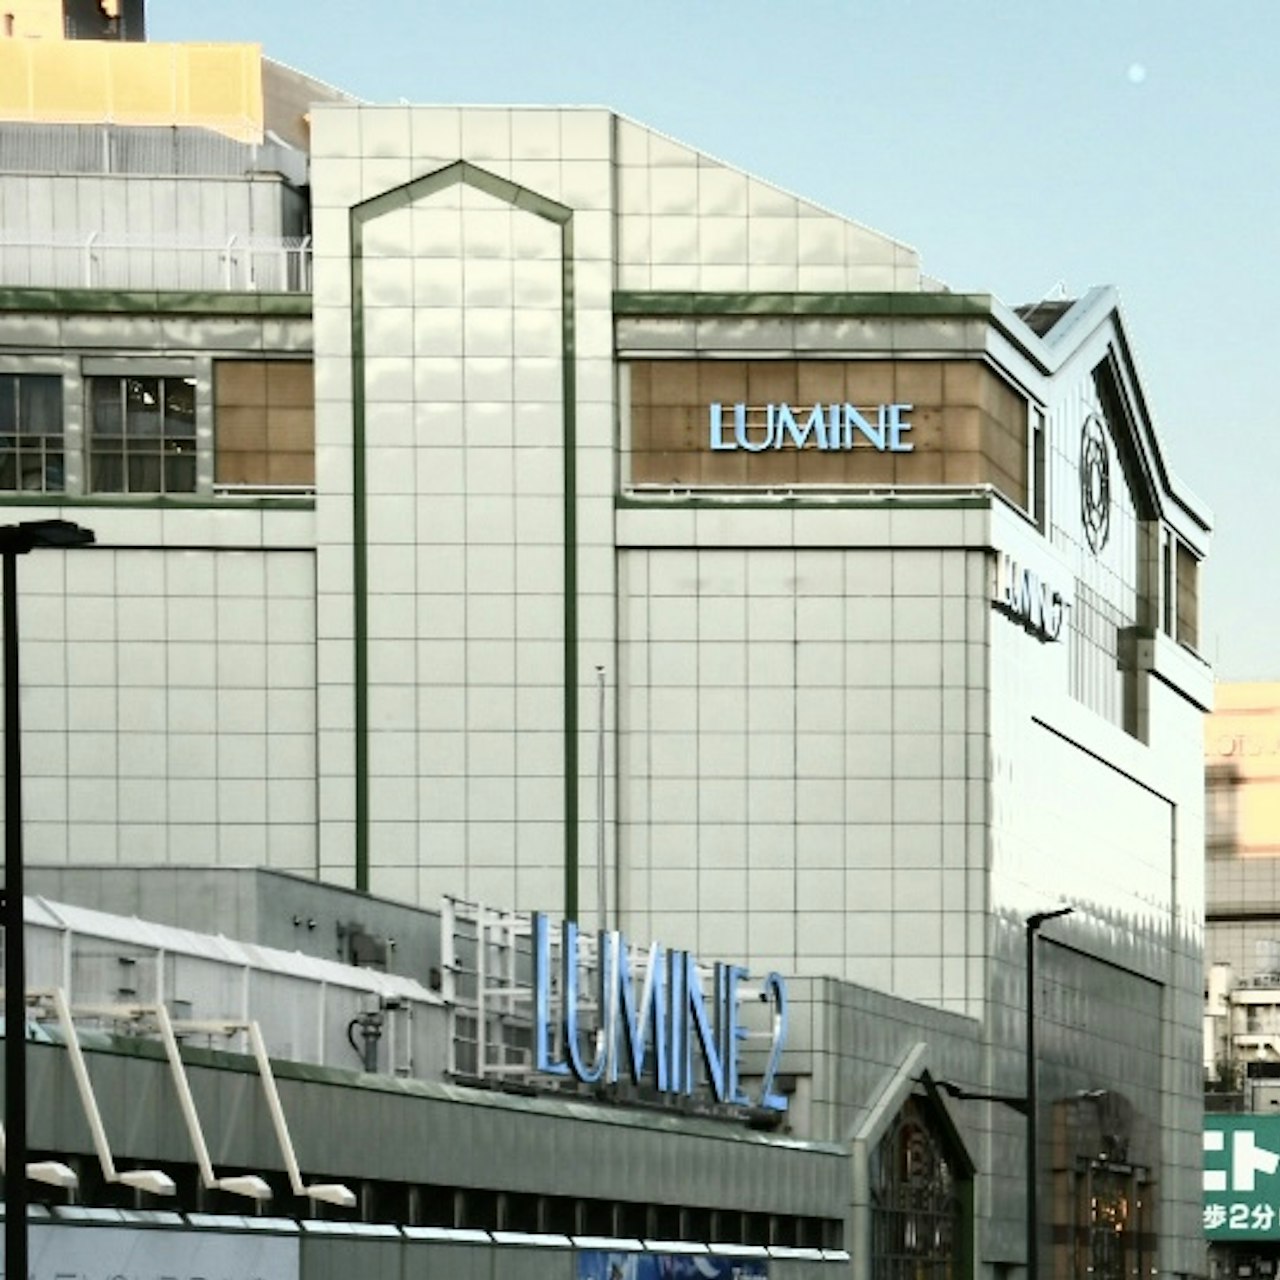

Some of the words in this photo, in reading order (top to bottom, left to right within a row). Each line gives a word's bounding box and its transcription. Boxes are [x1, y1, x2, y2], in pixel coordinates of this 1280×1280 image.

[709, 402, 914, 452] LUMINE
[532, 911, 749, 1106] LUMINE
[762, 972, 788, 1110] 2
[1203, 1203, 1276, 1230] 歩2分
